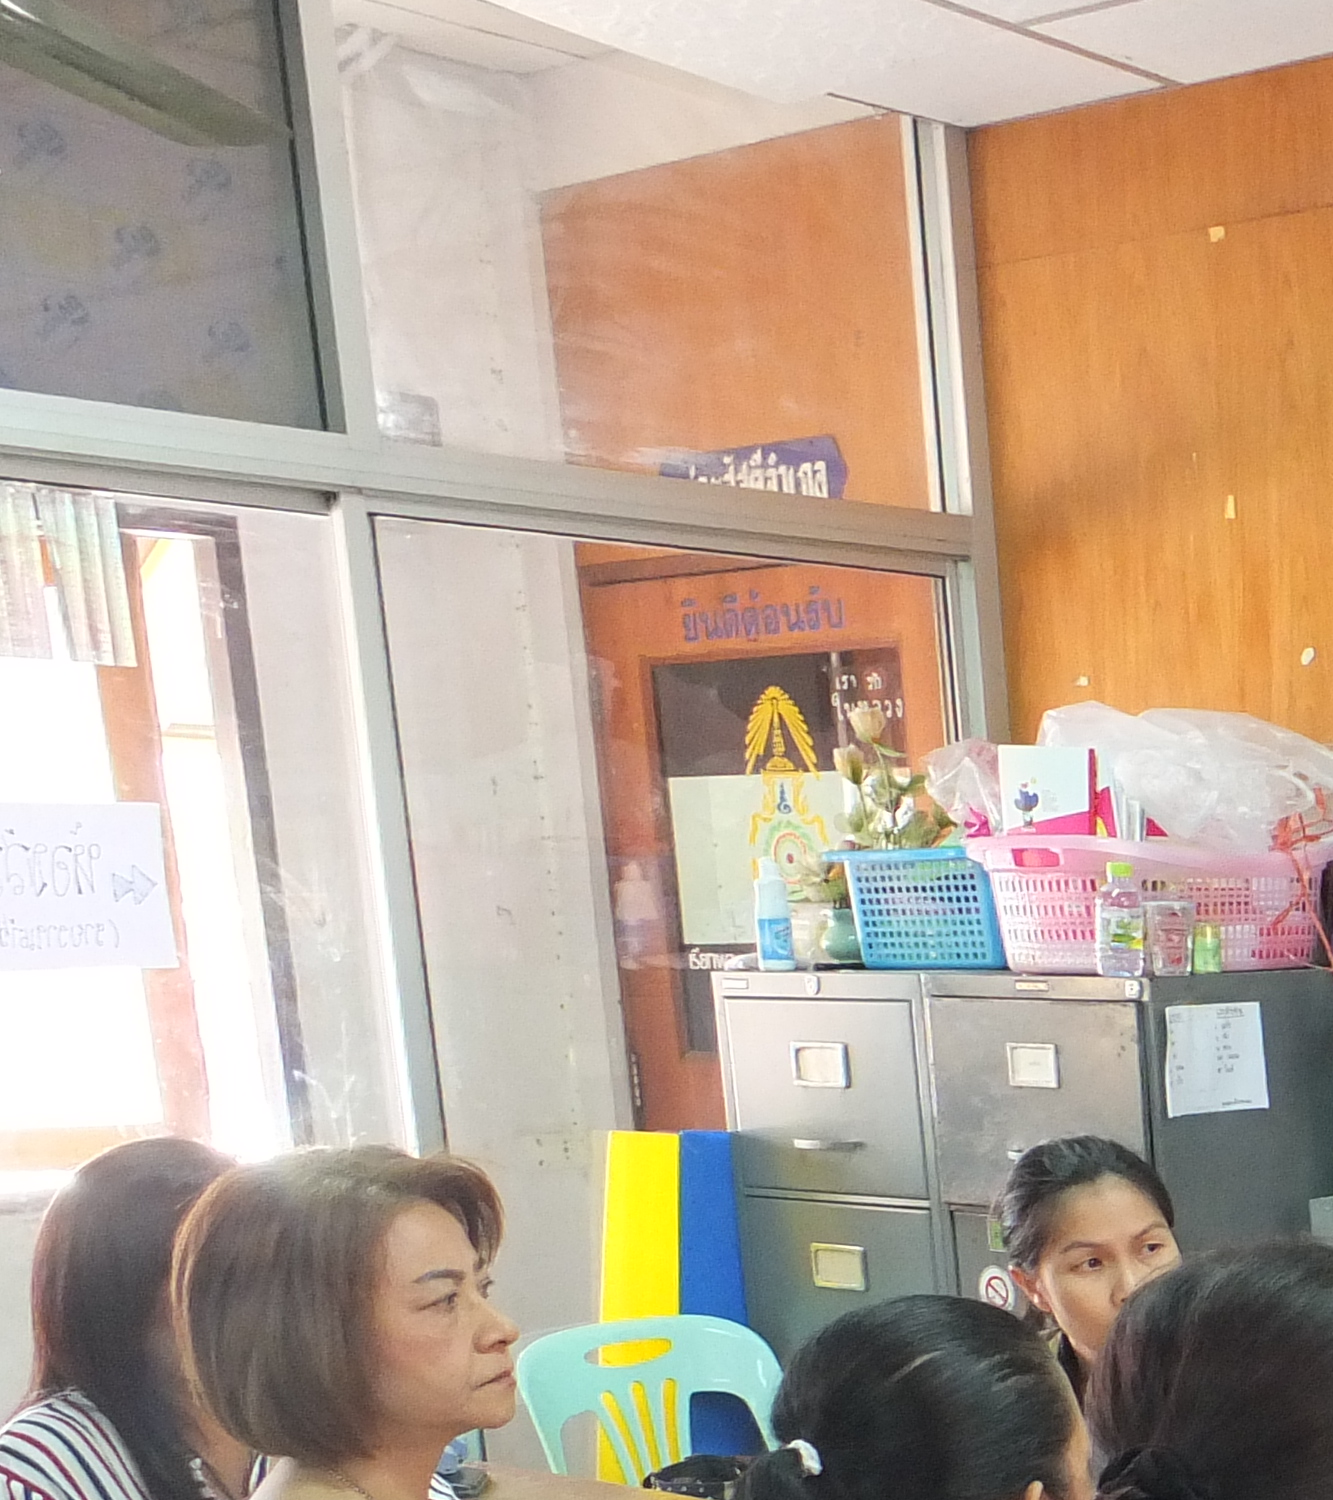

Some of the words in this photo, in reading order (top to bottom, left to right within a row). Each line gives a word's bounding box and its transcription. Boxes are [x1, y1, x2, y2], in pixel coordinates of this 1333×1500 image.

[680, 586, 846, 642] ยินดีต้อนรับ
